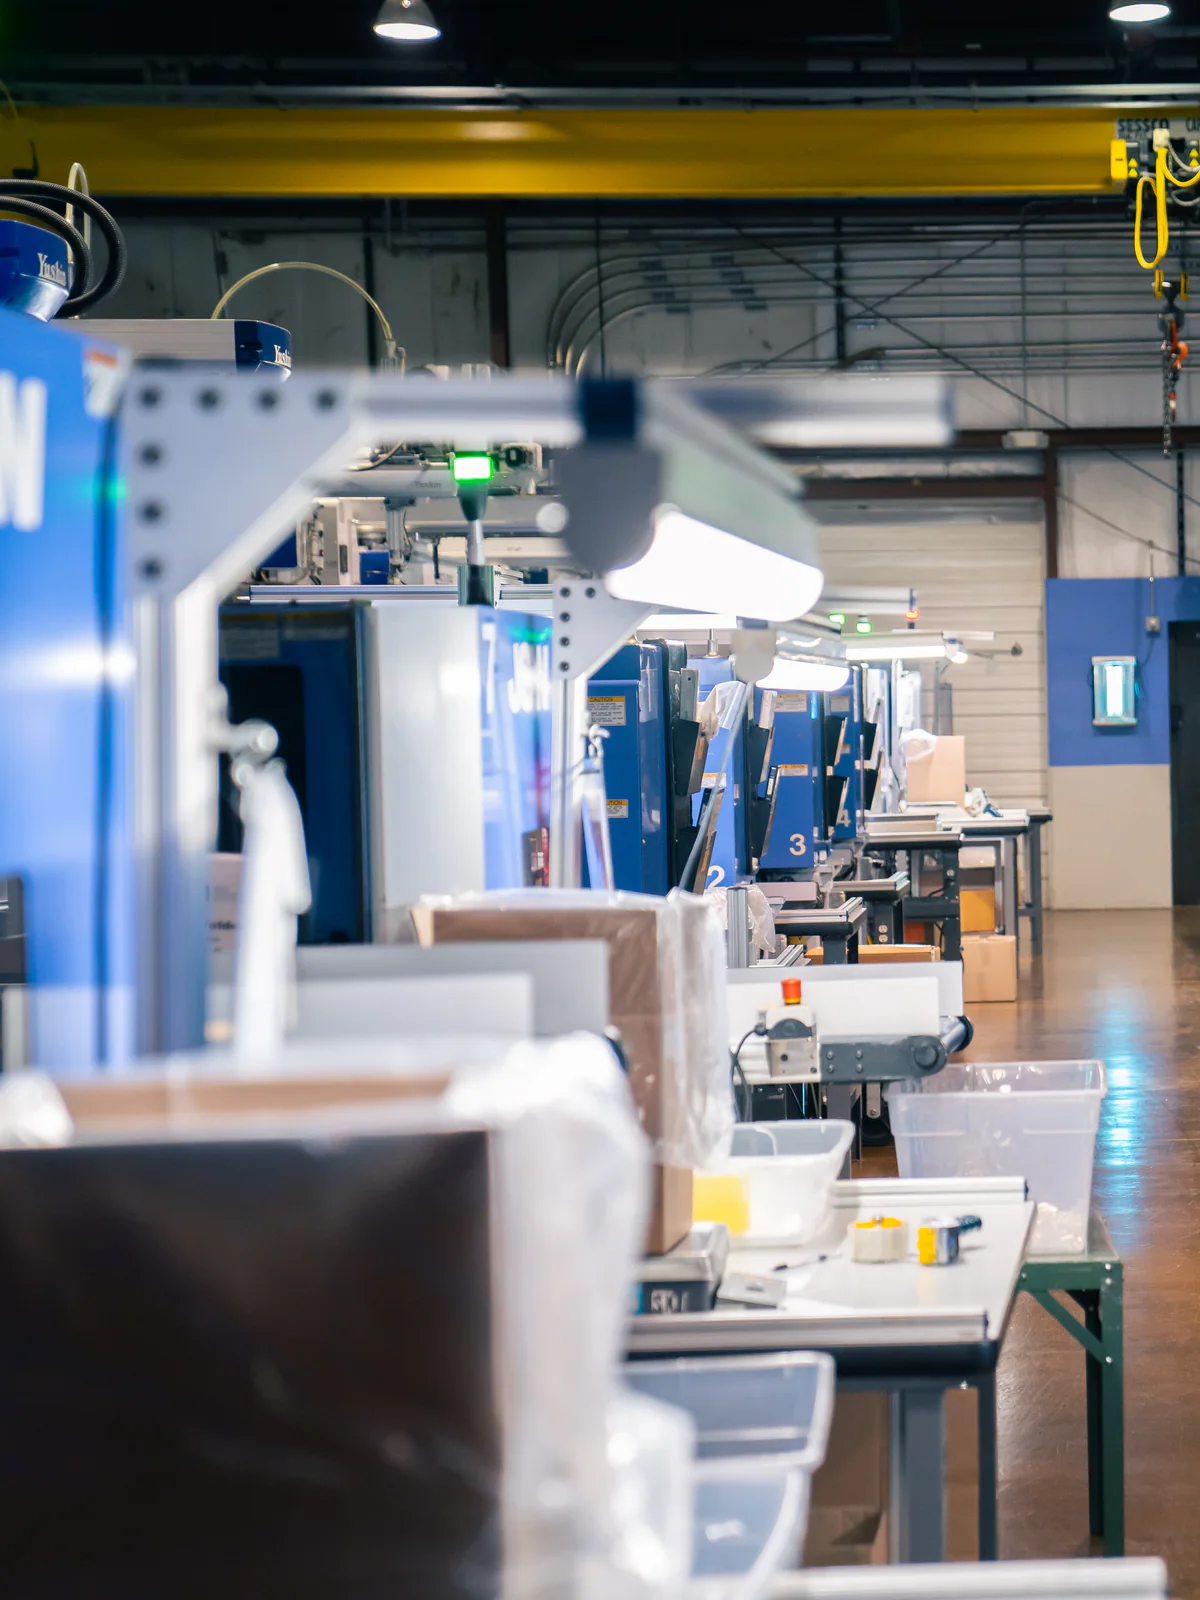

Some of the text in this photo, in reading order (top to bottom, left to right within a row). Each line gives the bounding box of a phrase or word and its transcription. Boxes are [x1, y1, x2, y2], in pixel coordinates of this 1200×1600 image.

[836, 809, 851, 828] 4
[789, 833, 807, 856] 3
[706, 865, 725, 889] 2
